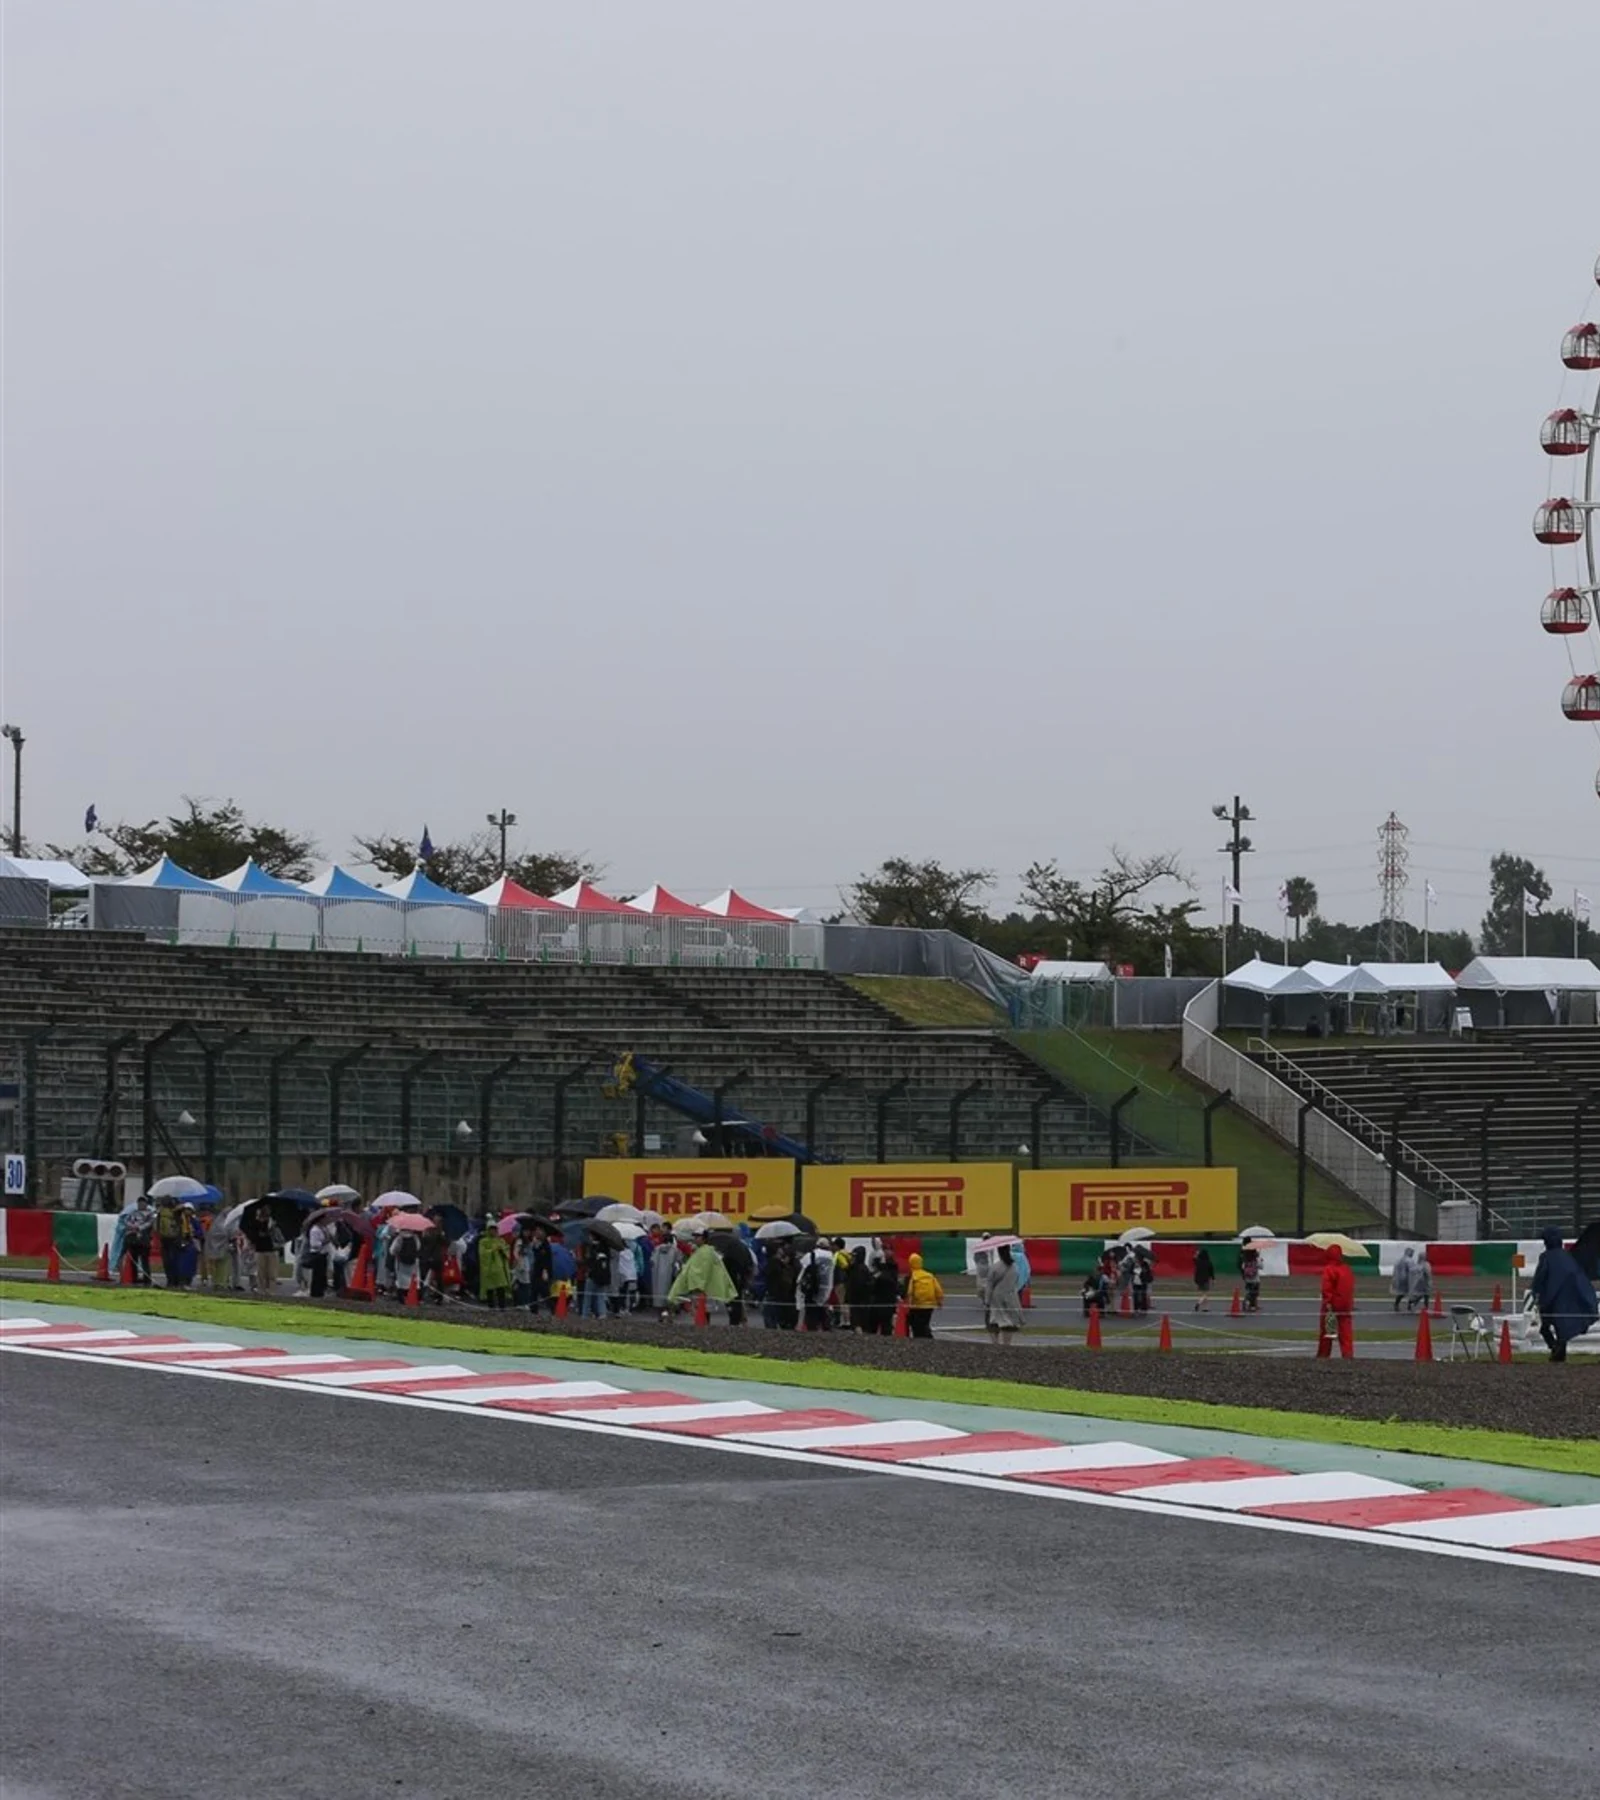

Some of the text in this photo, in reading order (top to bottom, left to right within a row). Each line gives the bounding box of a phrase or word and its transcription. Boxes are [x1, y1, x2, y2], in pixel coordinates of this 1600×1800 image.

[8, 1160, 23, 1188] 30
[633, 1173, 748, 1214] PIRELLI
[850, 1177, 965, 1218] PIRELLI
[1071, 1182, 1189, 1221] PIRELLI
